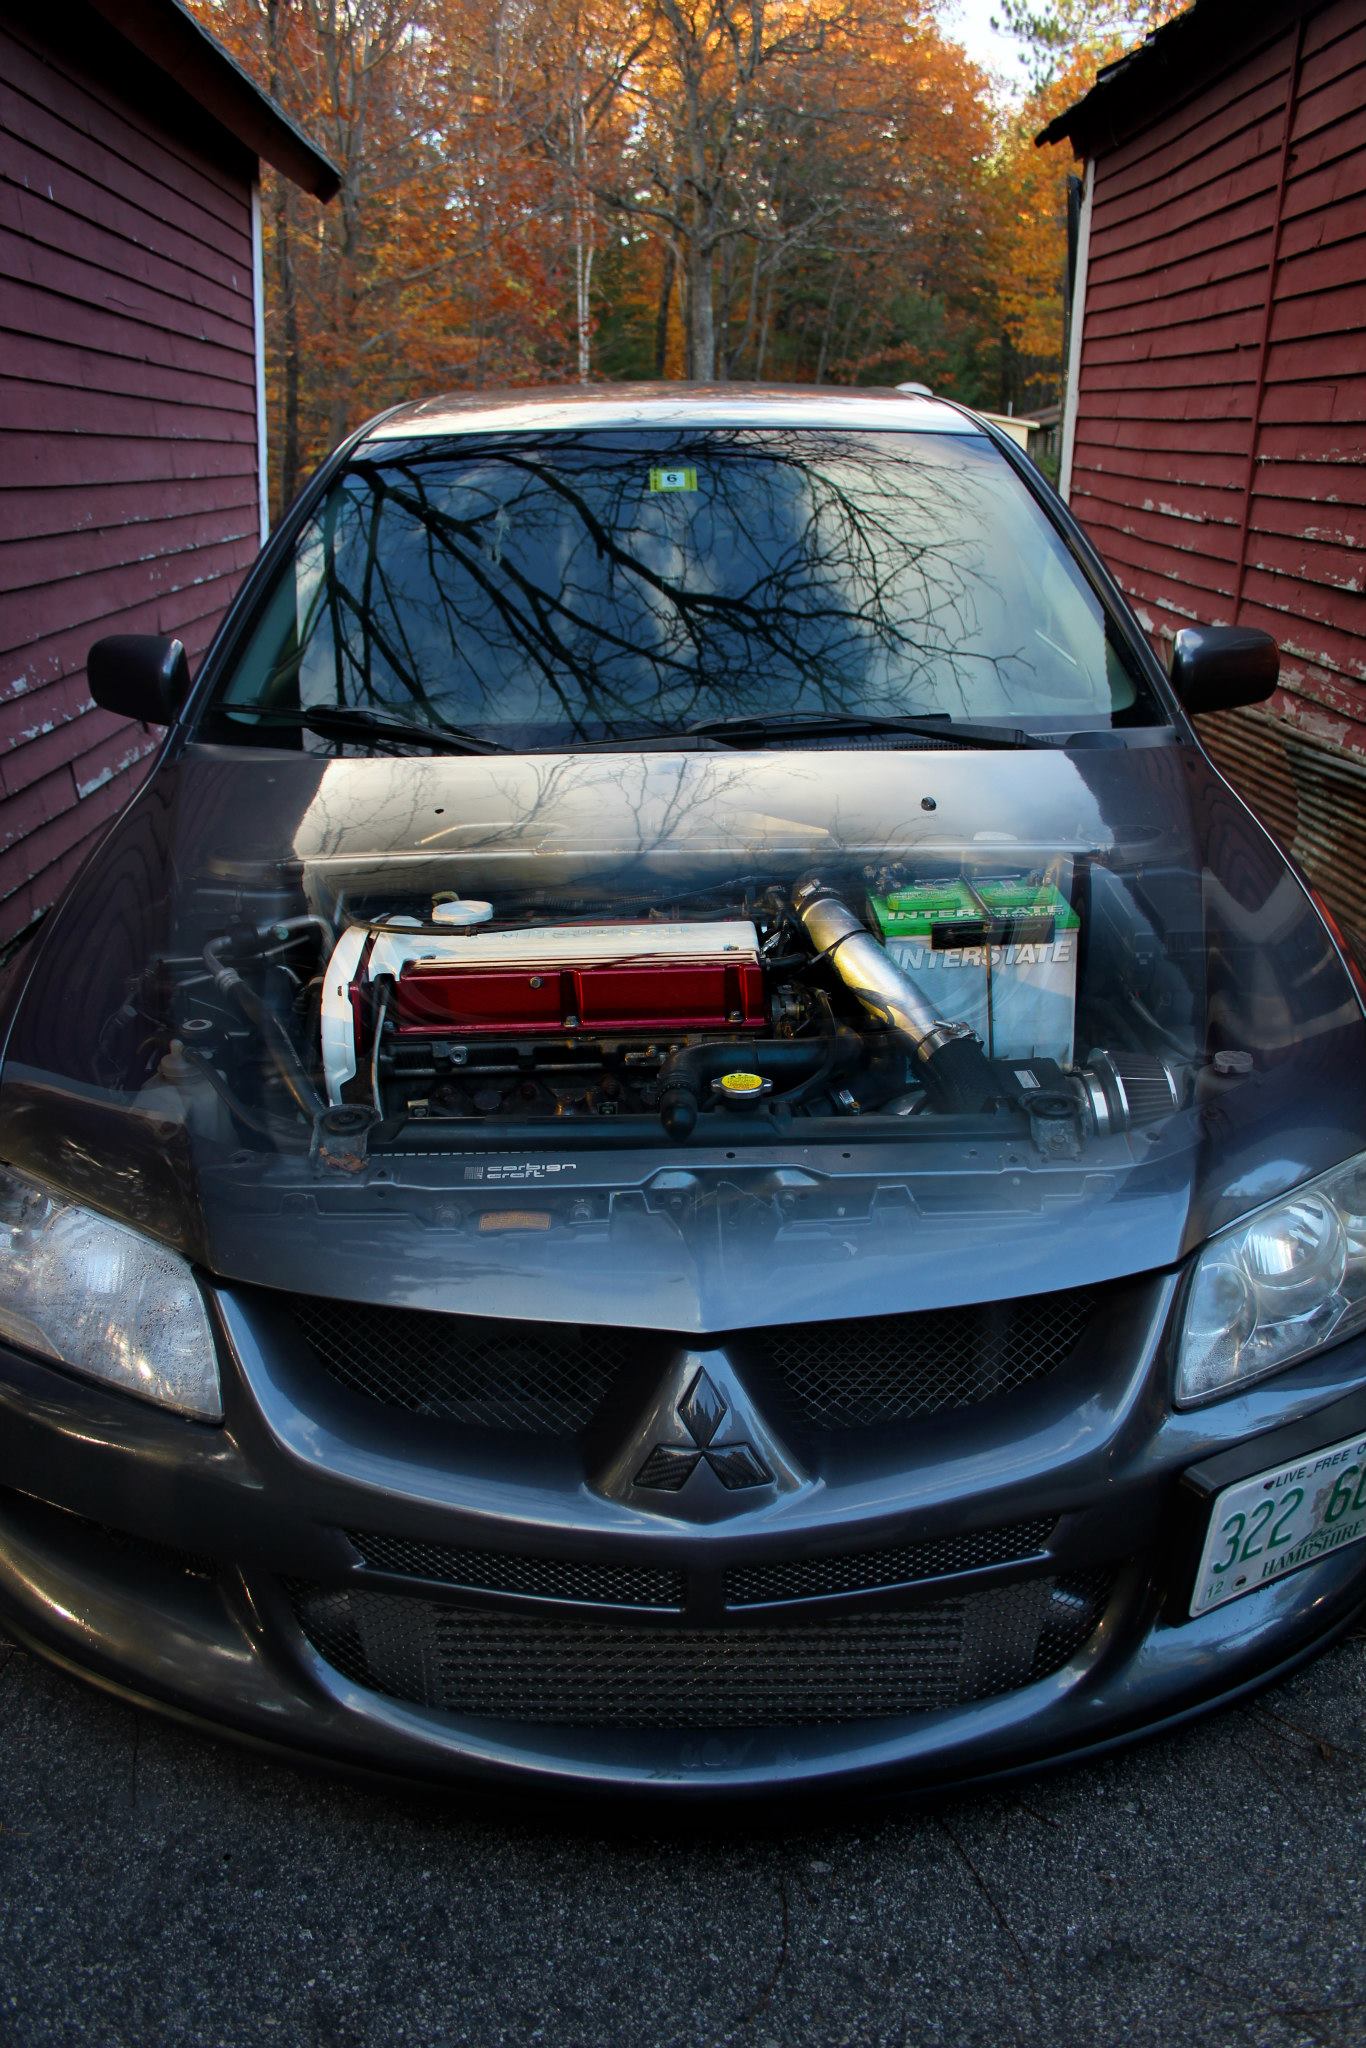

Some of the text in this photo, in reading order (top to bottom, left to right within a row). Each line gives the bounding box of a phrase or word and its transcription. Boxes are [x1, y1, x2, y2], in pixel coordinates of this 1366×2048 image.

[667, 474, 677, 483] 6
[888, 905, 1064, 920] INTERTATE
[893, 941, 1072, 970] INTERSTATE
[487, 1170, 545, 1179] craft
[1275, 1467, 1307, 1488] LIVE
[1313, 1450, 1350, 1476] FREE
[1212, 1487, 1305, 1574] 322
[1261, 1519, 1366, 1578] HAMPSHIRE
[1208, 1581, 1224, 1599] 12
